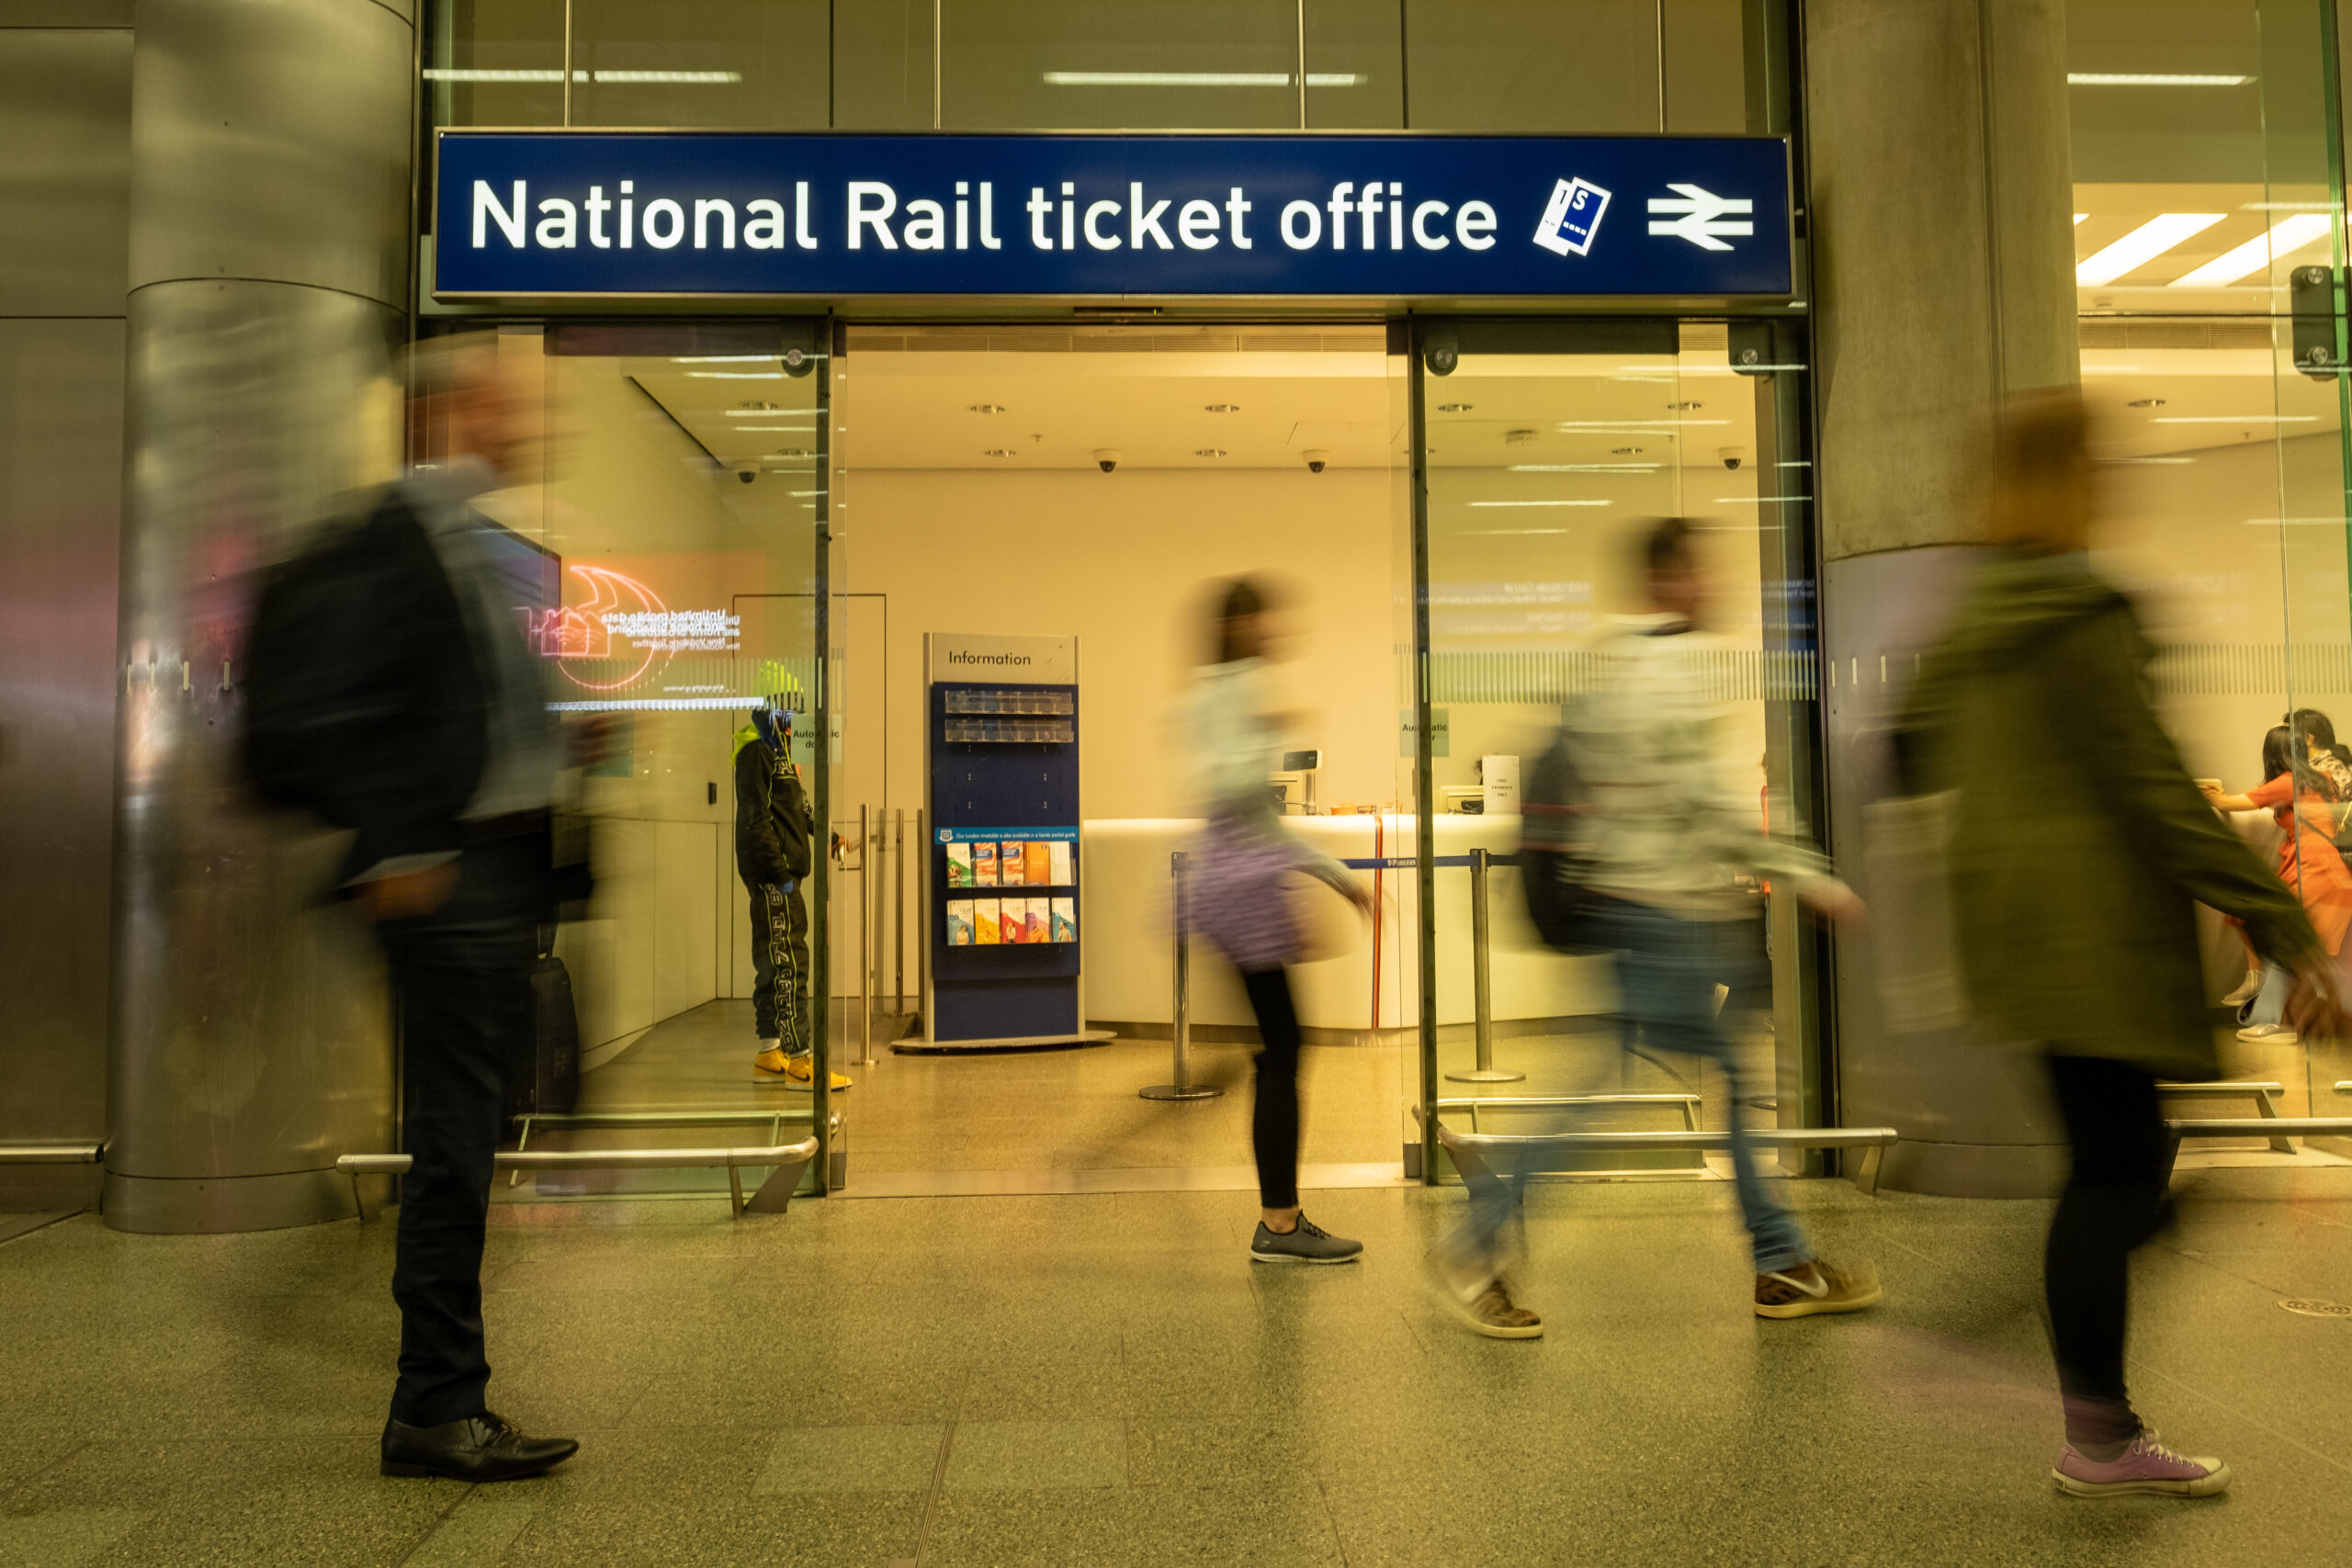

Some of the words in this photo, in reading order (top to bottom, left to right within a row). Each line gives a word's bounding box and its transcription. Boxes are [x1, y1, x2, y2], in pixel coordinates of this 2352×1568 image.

[1572, 189, 1589, 210] S
[472, 180, 817, 249] National
[847, 182, 1001, 250] Rail
[1026, 182, 1251, 250] ticket
[1280, 181, 1498, 250] office
[949, 650, 1031, 666] Information
[793, 729, 840, 738] Autoic
[1402, 723, 1448, 732] Auatic
